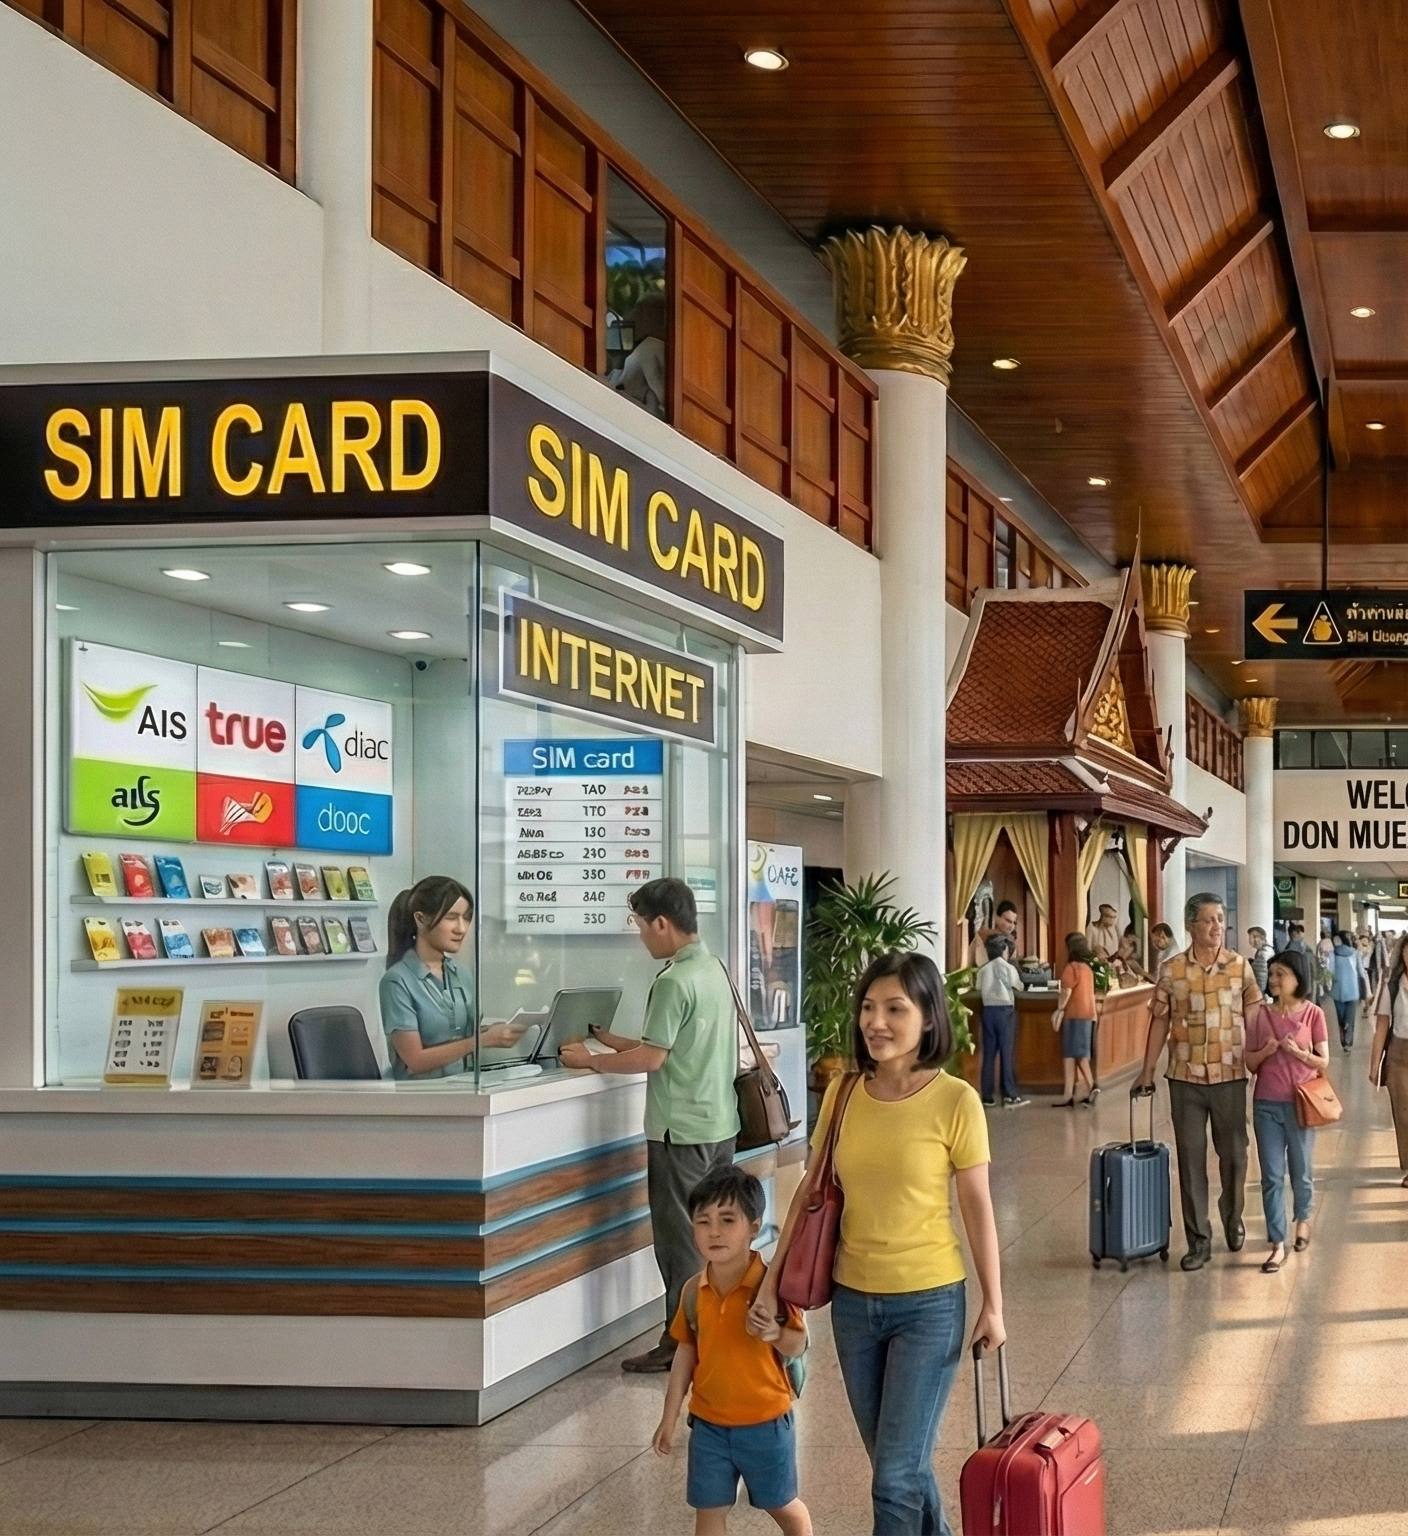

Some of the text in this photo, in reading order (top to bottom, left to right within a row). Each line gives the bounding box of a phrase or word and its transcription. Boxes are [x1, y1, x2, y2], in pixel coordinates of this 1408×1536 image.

[43, 399, 442, 500] SIM CARD
[527, 422, 767, 612] SIM CARD
[517, 617, 706, 724] INTERNET
[137, 705, 187, 740] AIS
[205, 702, 287, 754] true
[532, 745, 635, 769] SIM card
[1283, 820, 1339, 850] DON
